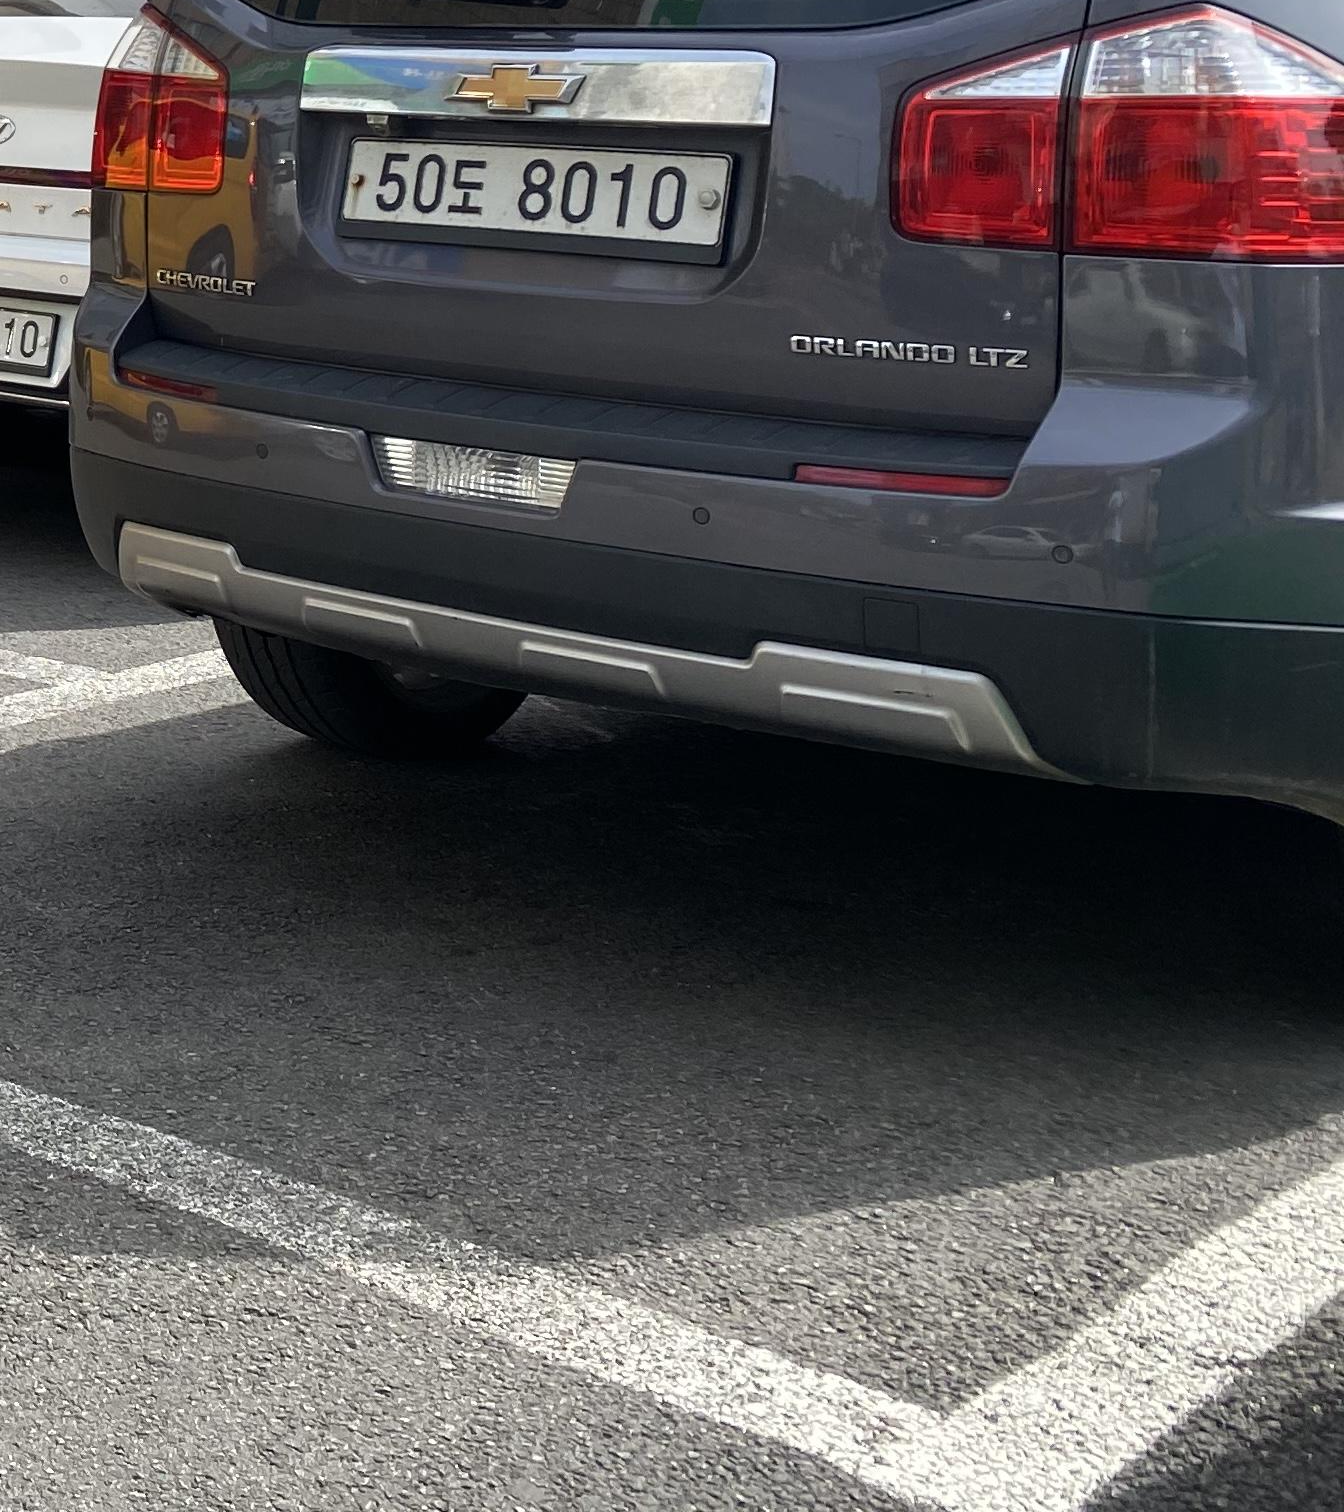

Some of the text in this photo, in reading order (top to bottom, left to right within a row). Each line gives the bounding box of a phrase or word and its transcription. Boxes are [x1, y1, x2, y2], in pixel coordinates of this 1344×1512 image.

[375, 152, 688, 231] 50도 8010
[156, 269, 256, 297] CHEVROLET
[790, 334, 1029, 369] ORLANDO LTZ
